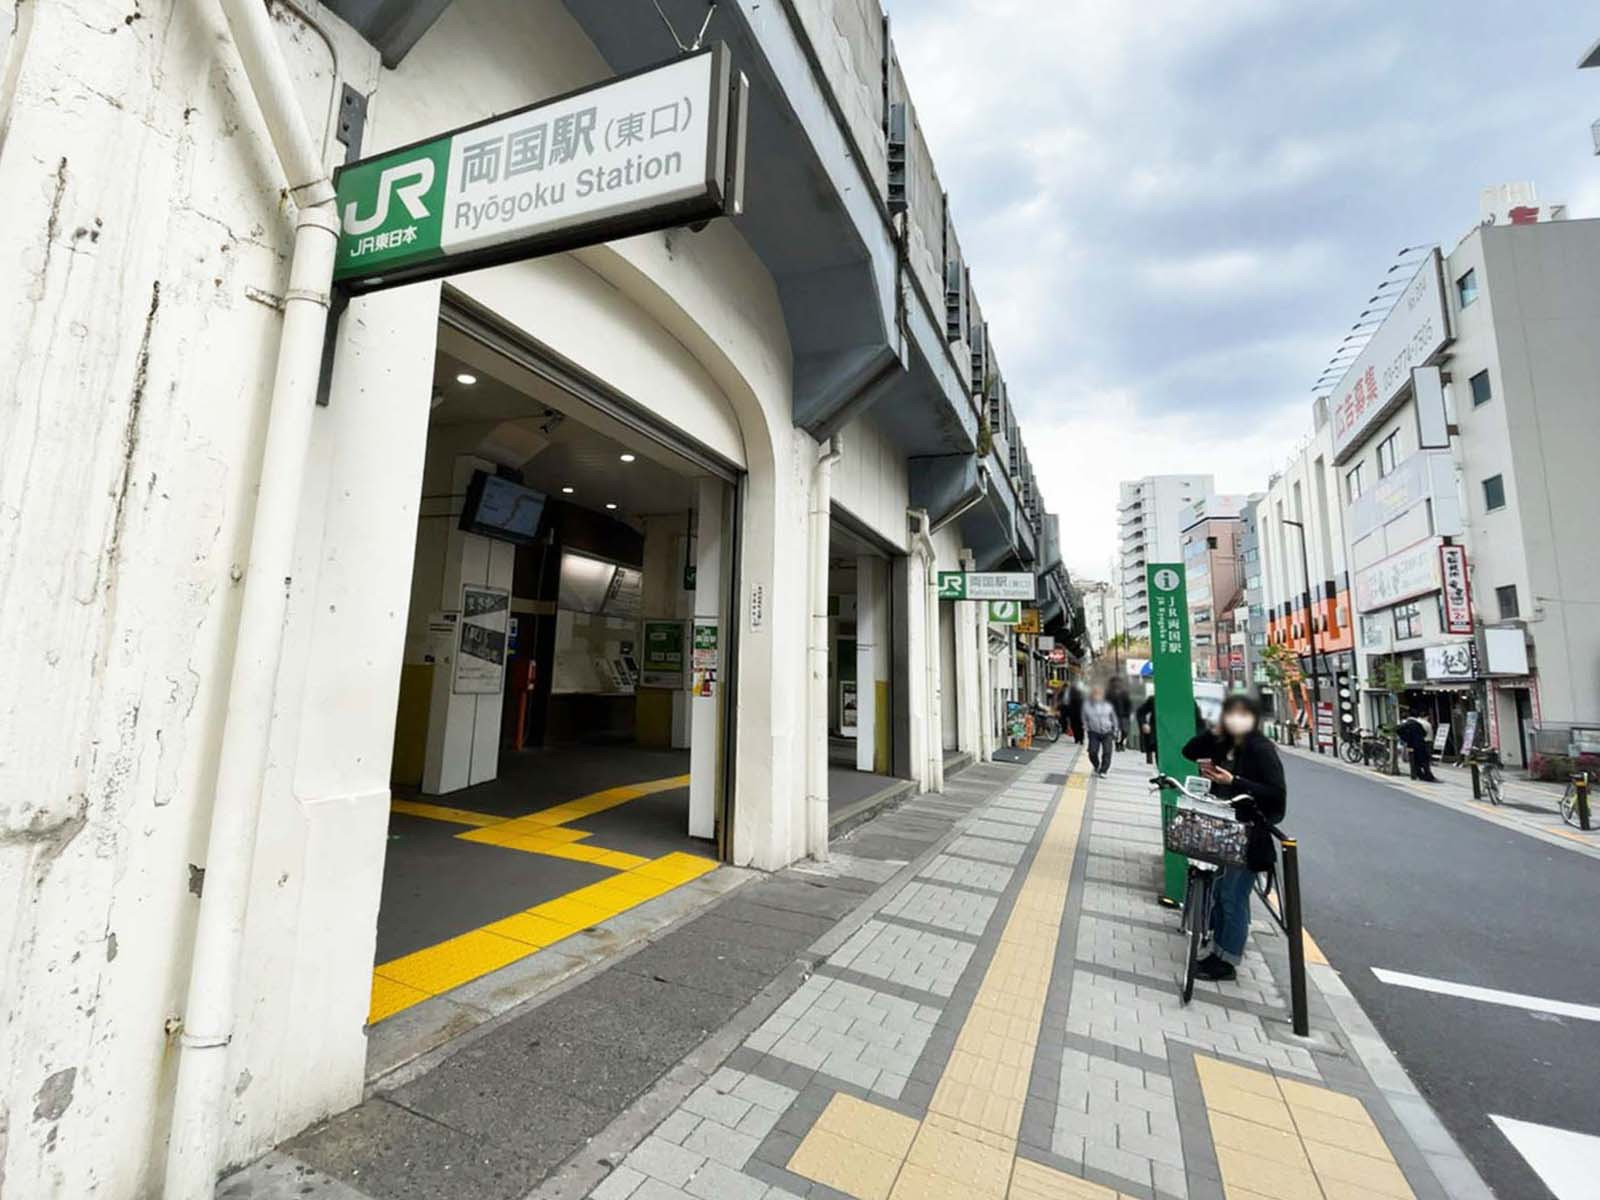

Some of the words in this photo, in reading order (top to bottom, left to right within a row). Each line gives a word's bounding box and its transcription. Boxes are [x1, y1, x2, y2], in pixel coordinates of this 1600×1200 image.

[343, 156, 436, 234] JR
[454, 182, 566, 234] Ryōgoku
[576, 149, 682, 197] Station
[350, 225, 418, 257] JR東日本
[939, 575, 962, 591] JR
